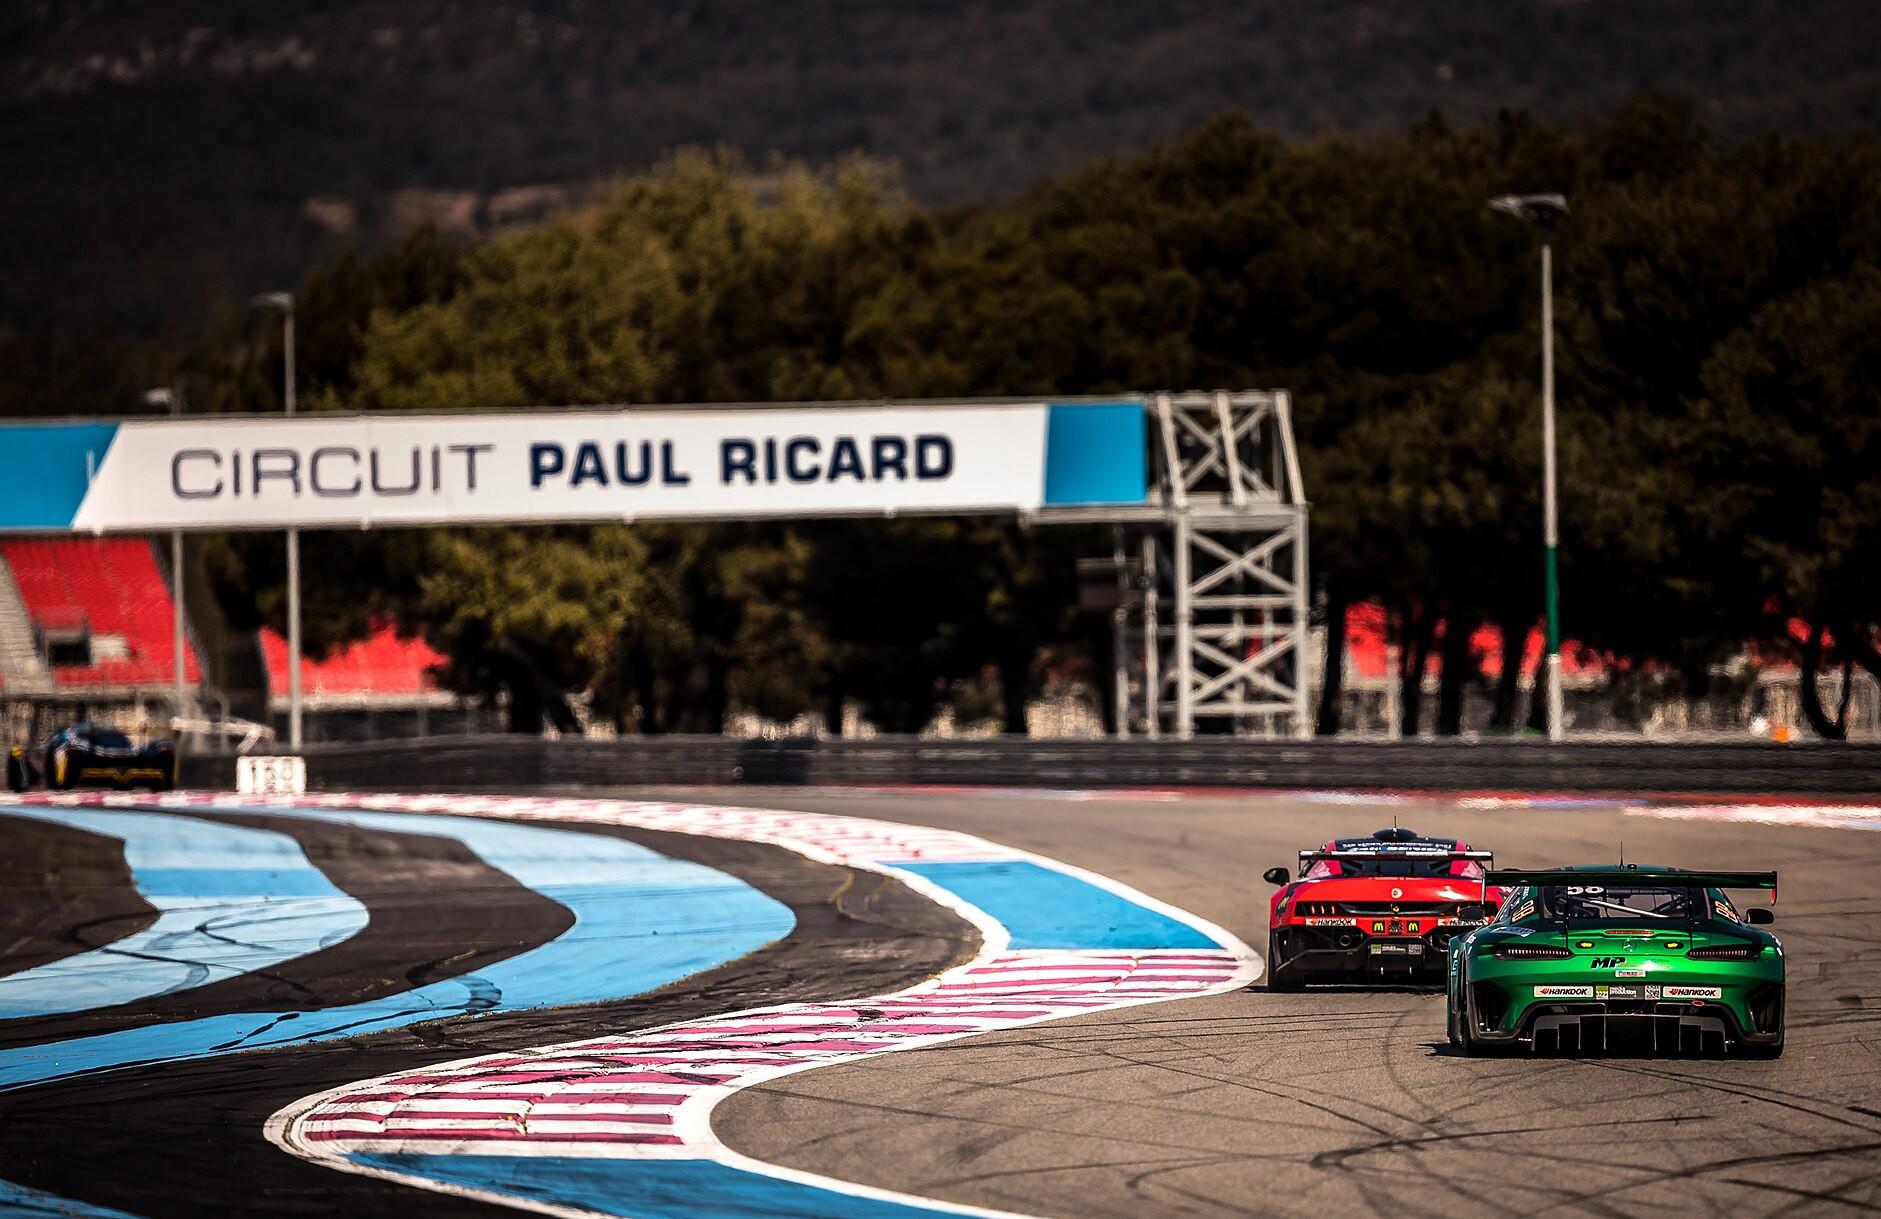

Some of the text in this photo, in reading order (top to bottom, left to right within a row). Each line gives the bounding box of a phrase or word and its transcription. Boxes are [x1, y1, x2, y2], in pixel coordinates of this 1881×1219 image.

[171, 432, 955, 499] CIRCUIT PAUL RICARD
[1591, 957, 1626, 968] MP
